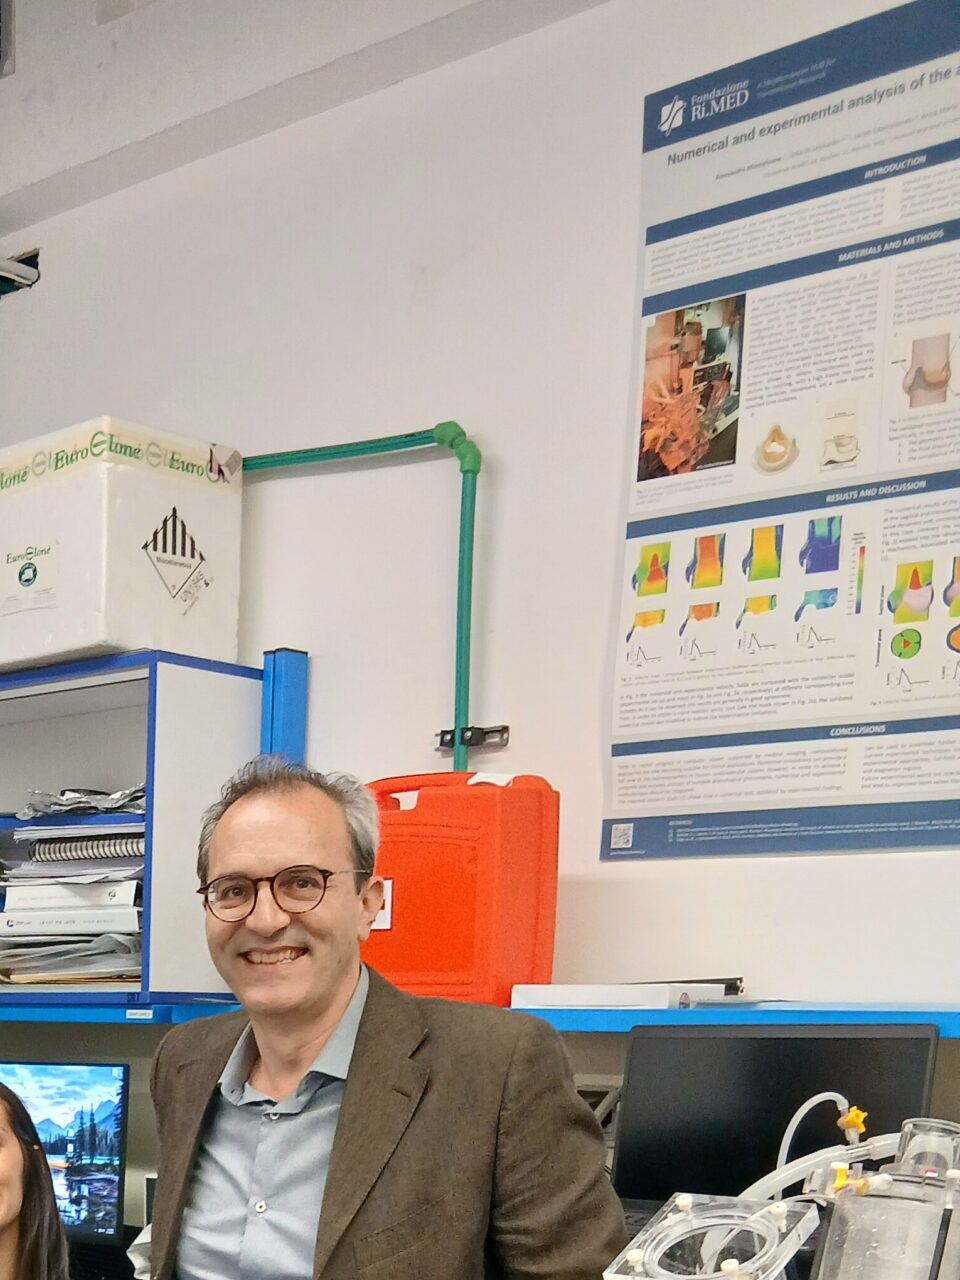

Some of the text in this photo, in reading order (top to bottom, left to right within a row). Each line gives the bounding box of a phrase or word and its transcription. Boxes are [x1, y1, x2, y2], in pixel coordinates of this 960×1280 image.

[691, 80, 749, 105] Fondazione
[667, 136, 728, 166] Numerical
[732, 127, 755, 146] and
[759, 100, 844, 137] experimental
[848, 82, 905, 110] analysis
[910, 73, 925, 90] of
[929, 67, 952, 85] the
[864, 155, 927, 179] INTRODUCTION
[838, 229, 944, 262] MATERIALS AND METHODS
[826, 480, 927, 503] RESULTS AND DISCUSSION
[830, 725, 886, 737] CONCLUSIONS
